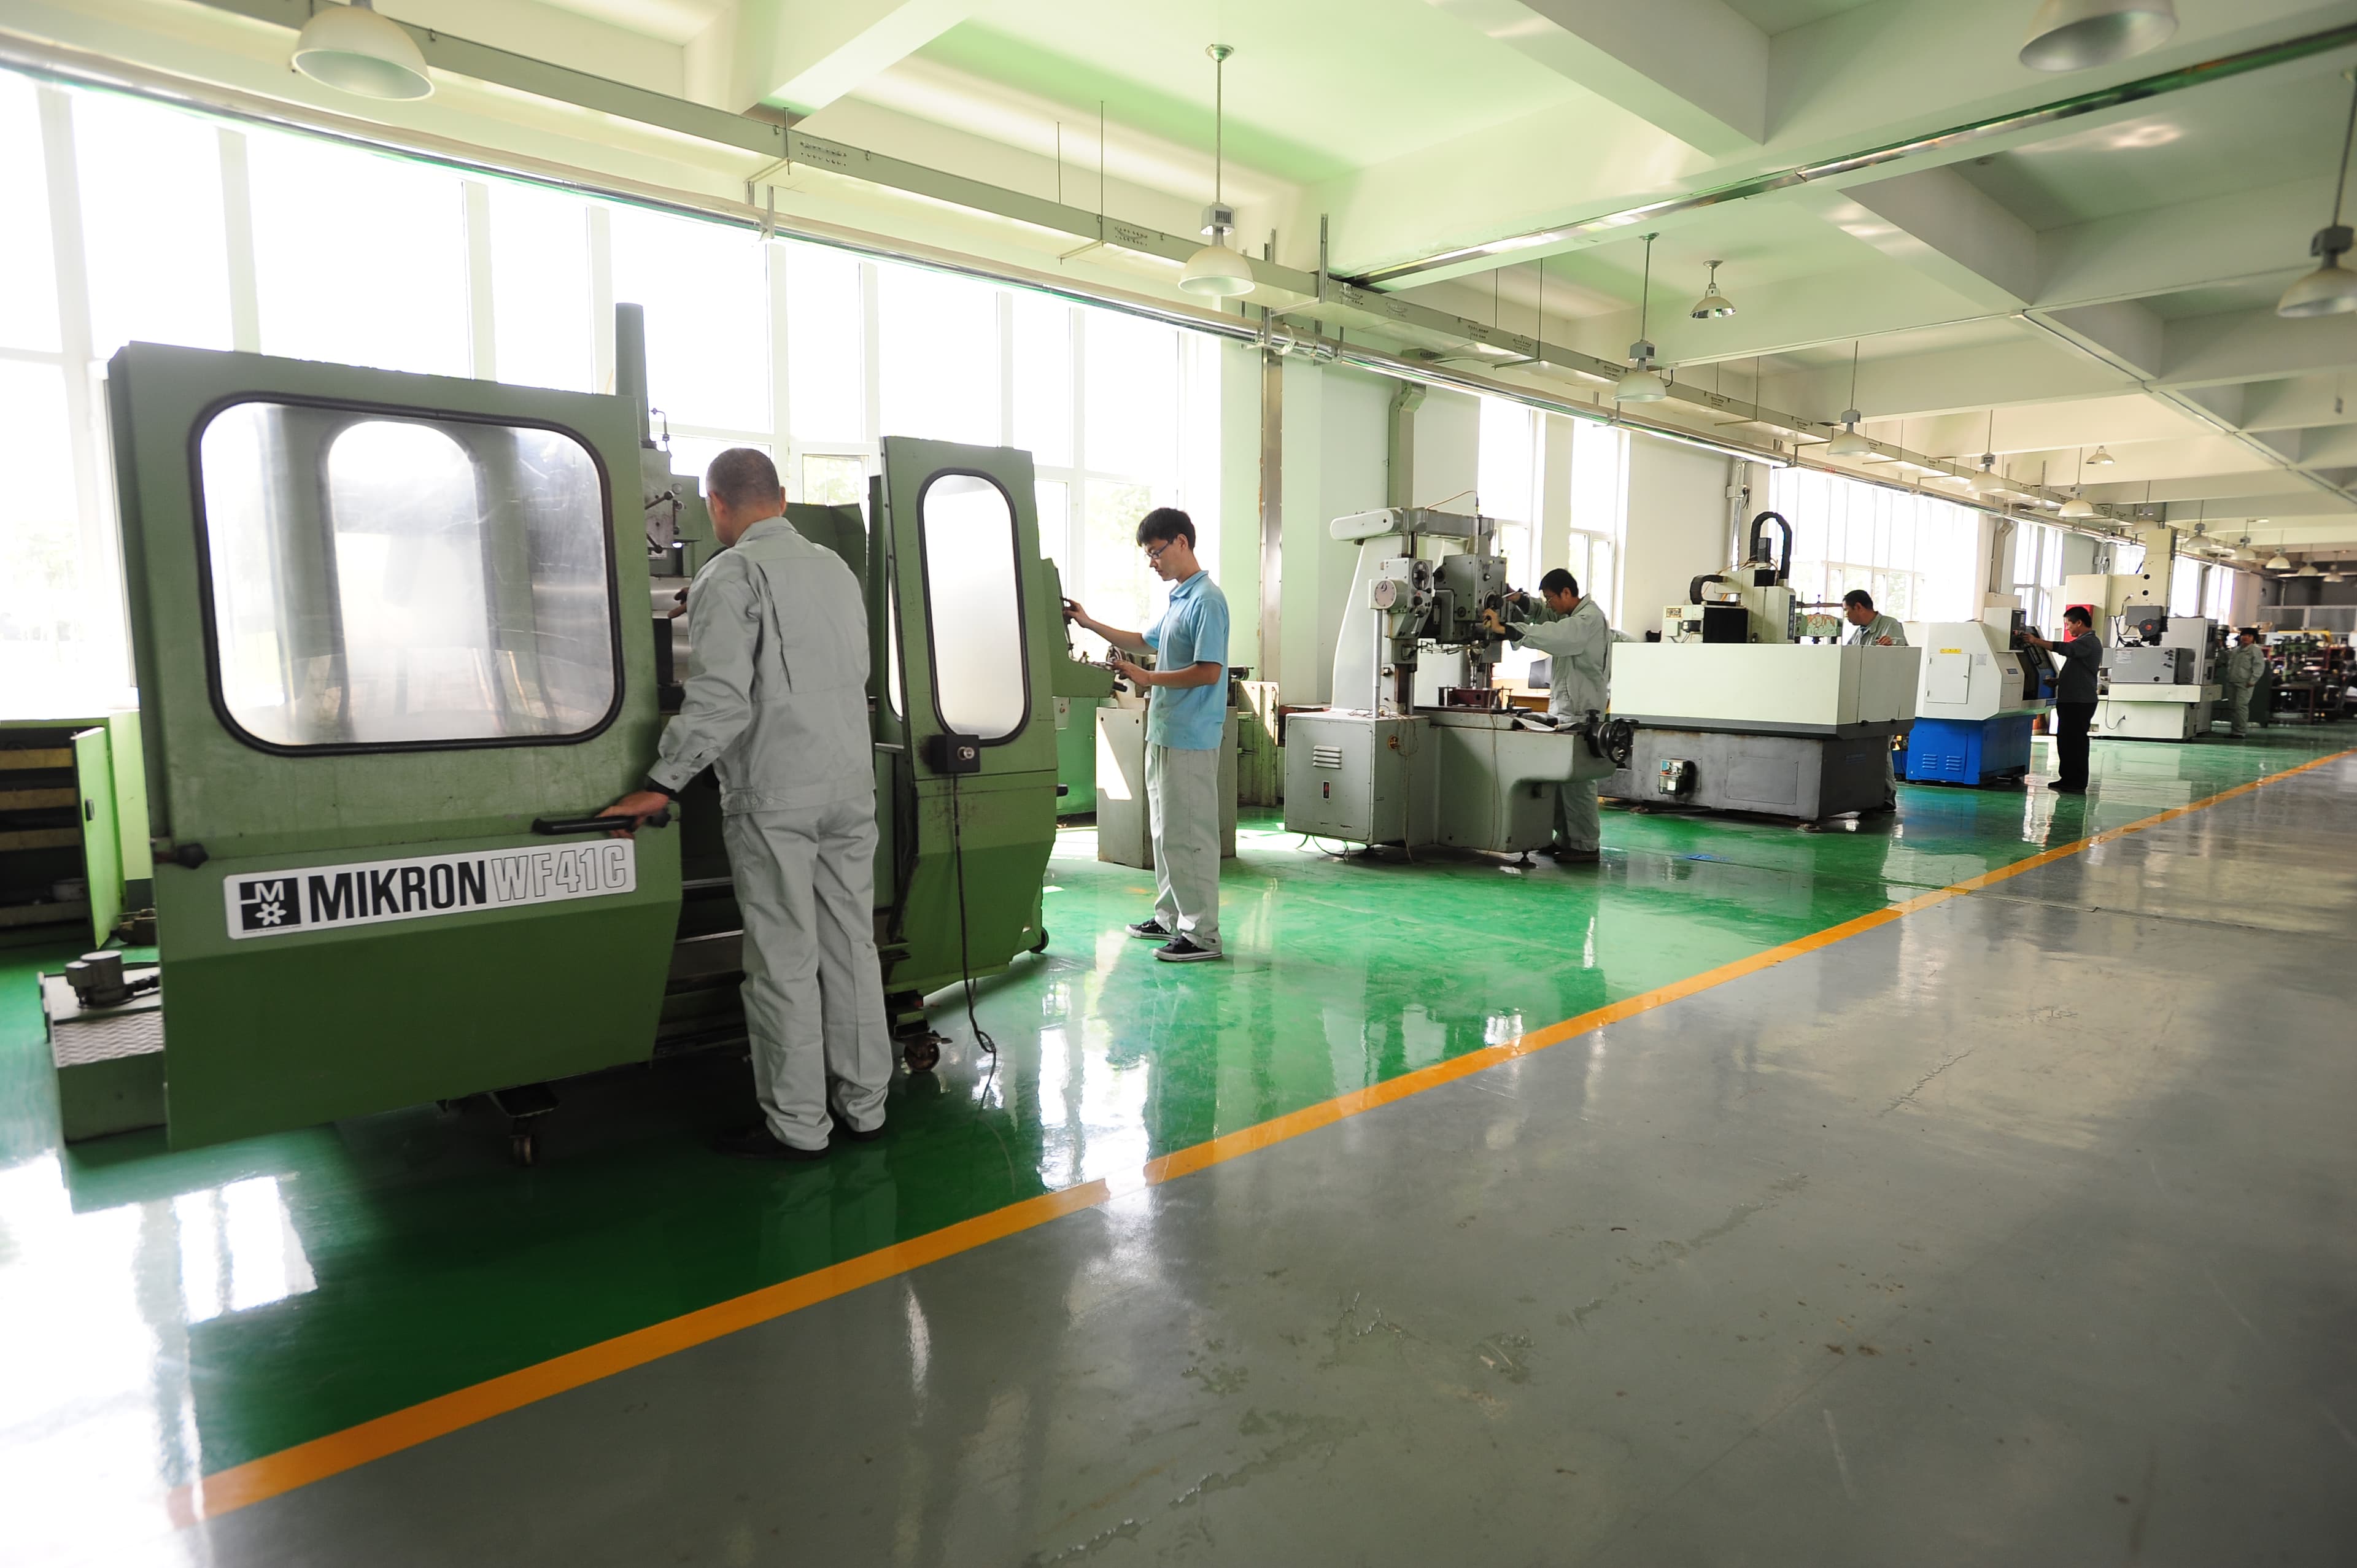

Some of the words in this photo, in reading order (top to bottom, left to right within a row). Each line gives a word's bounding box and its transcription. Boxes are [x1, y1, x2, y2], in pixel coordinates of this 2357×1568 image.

[254, 881, 285, 902] M
[308, 860, 487, 923] MIKRON
[491, 845, 627, 902] WF41C
